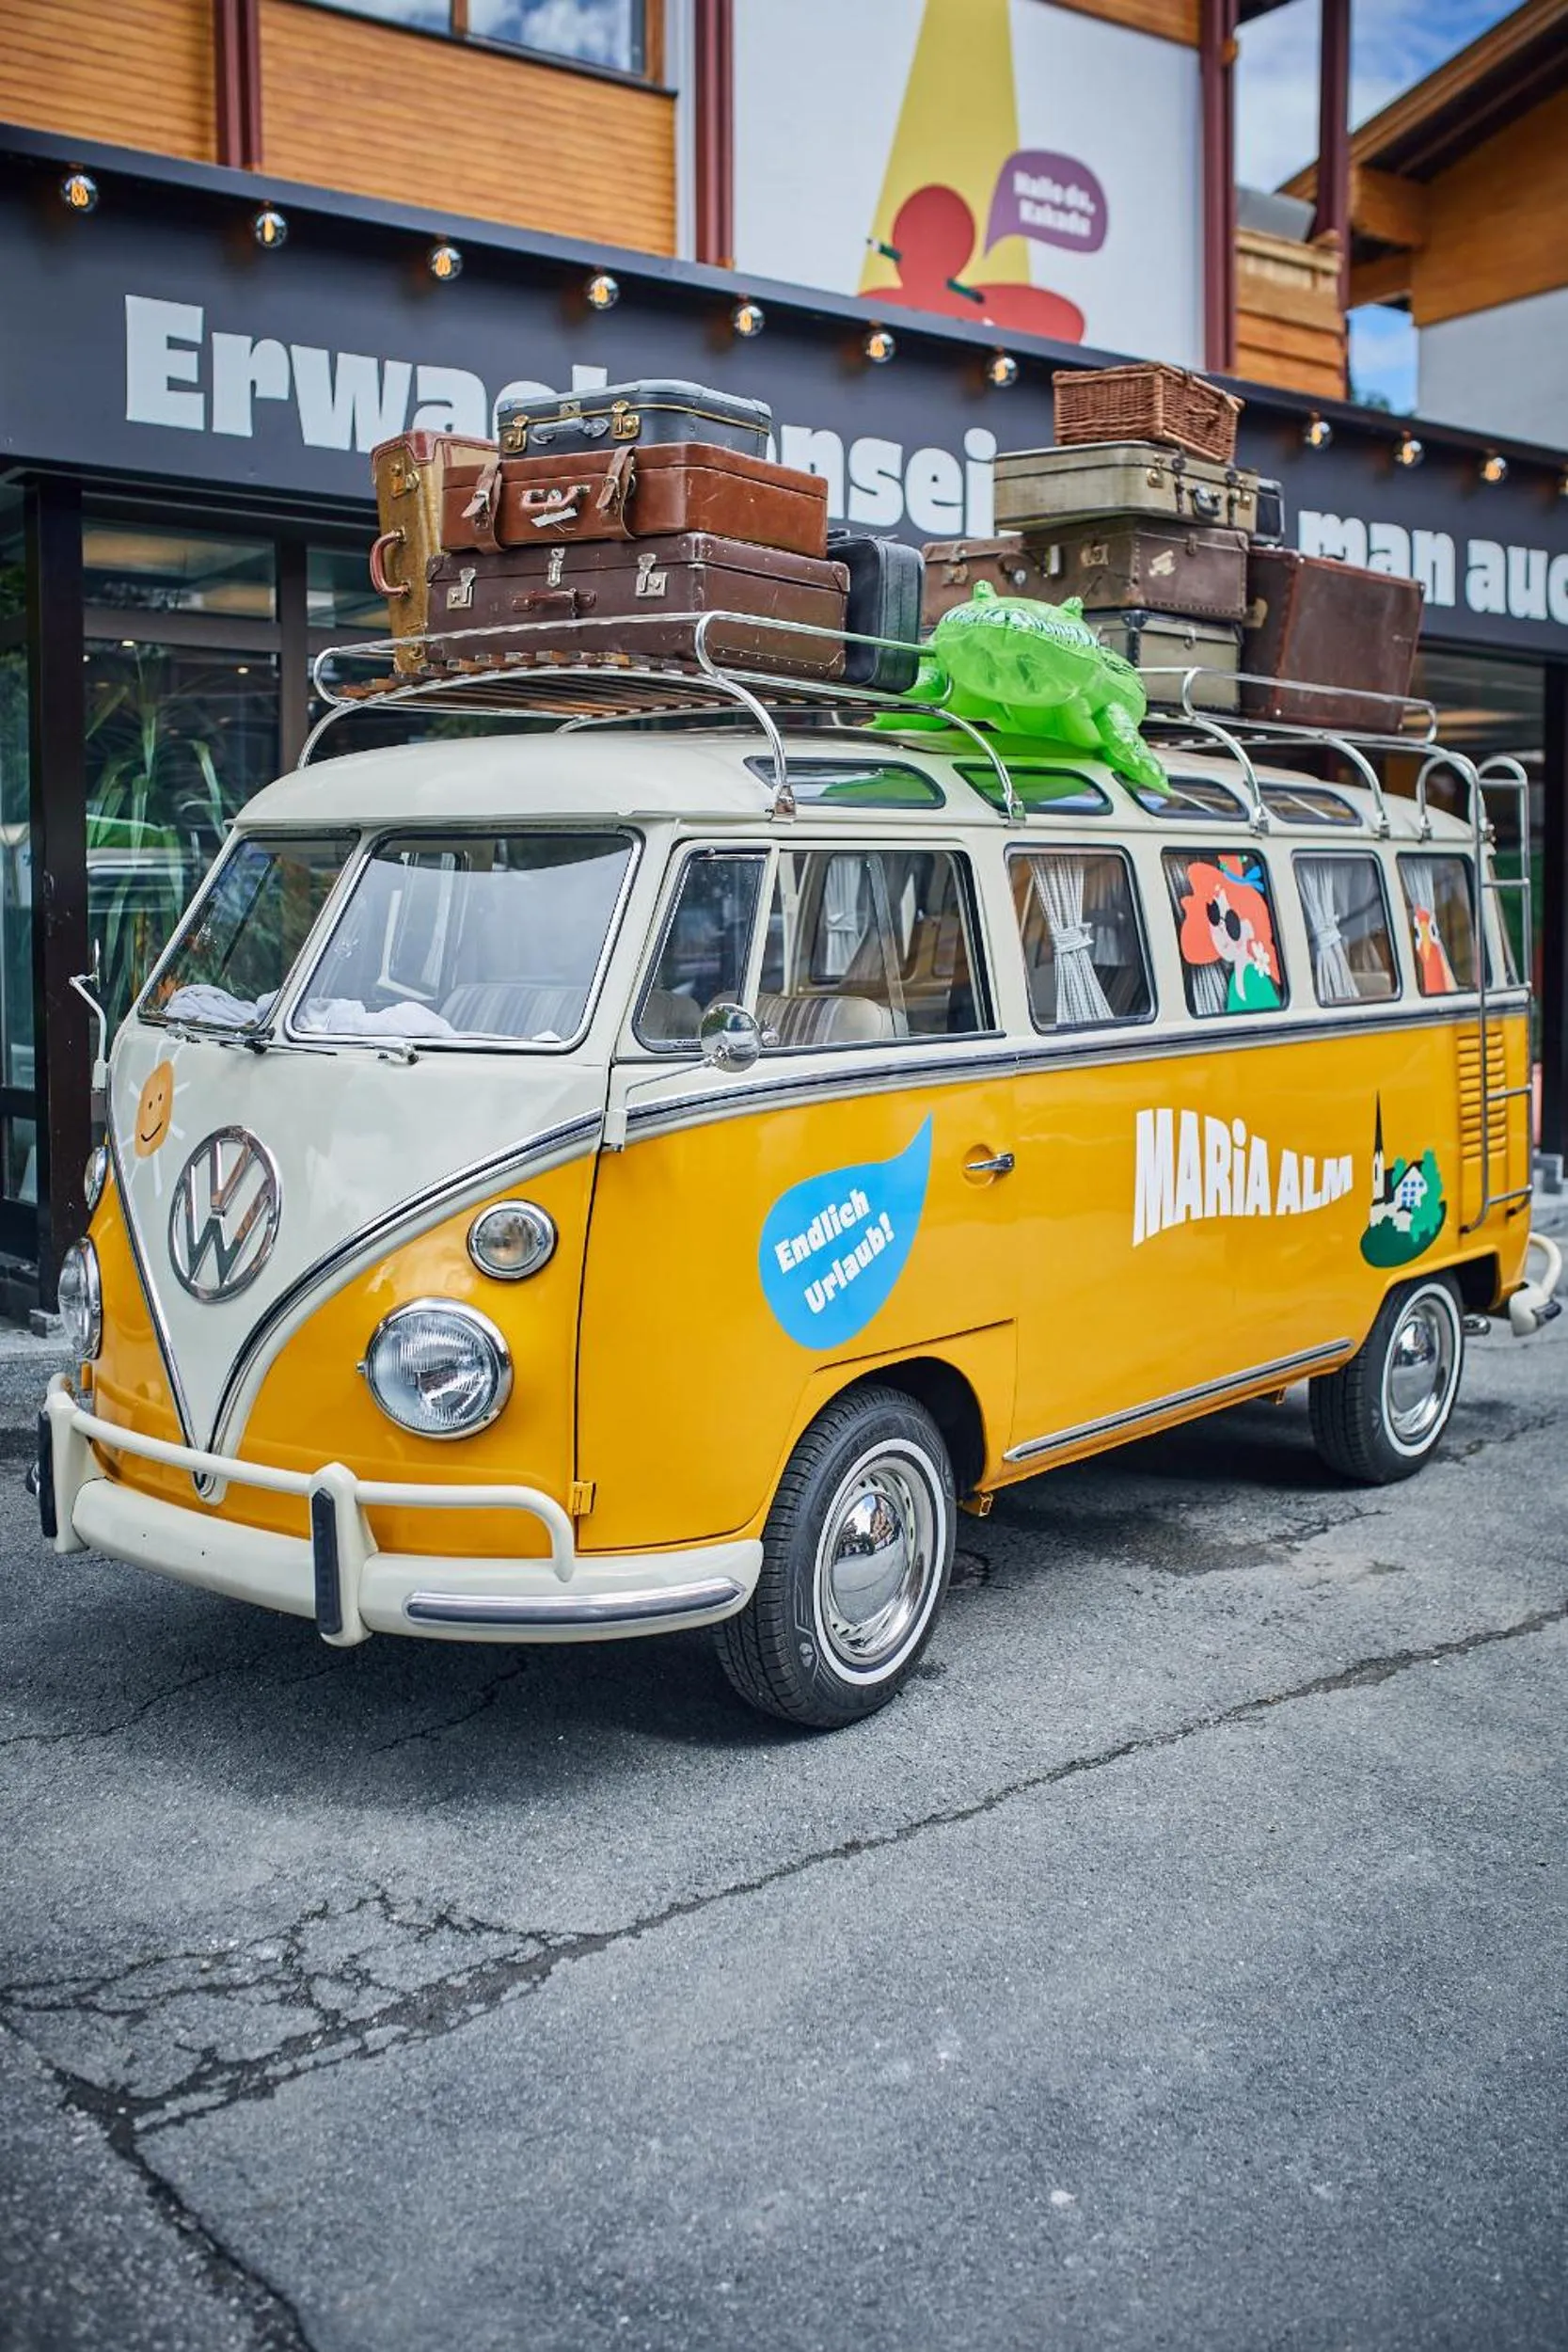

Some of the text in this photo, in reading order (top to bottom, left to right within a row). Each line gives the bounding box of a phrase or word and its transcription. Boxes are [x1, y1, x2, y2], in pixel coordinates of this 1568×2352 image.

[1298, 510, 1455, 607] man
[1275, 1149, 1354, 1216] ALM
[774, 1188, 871, 1275] Endlich
[803, 1212, 895, 1315] Urlaub!
